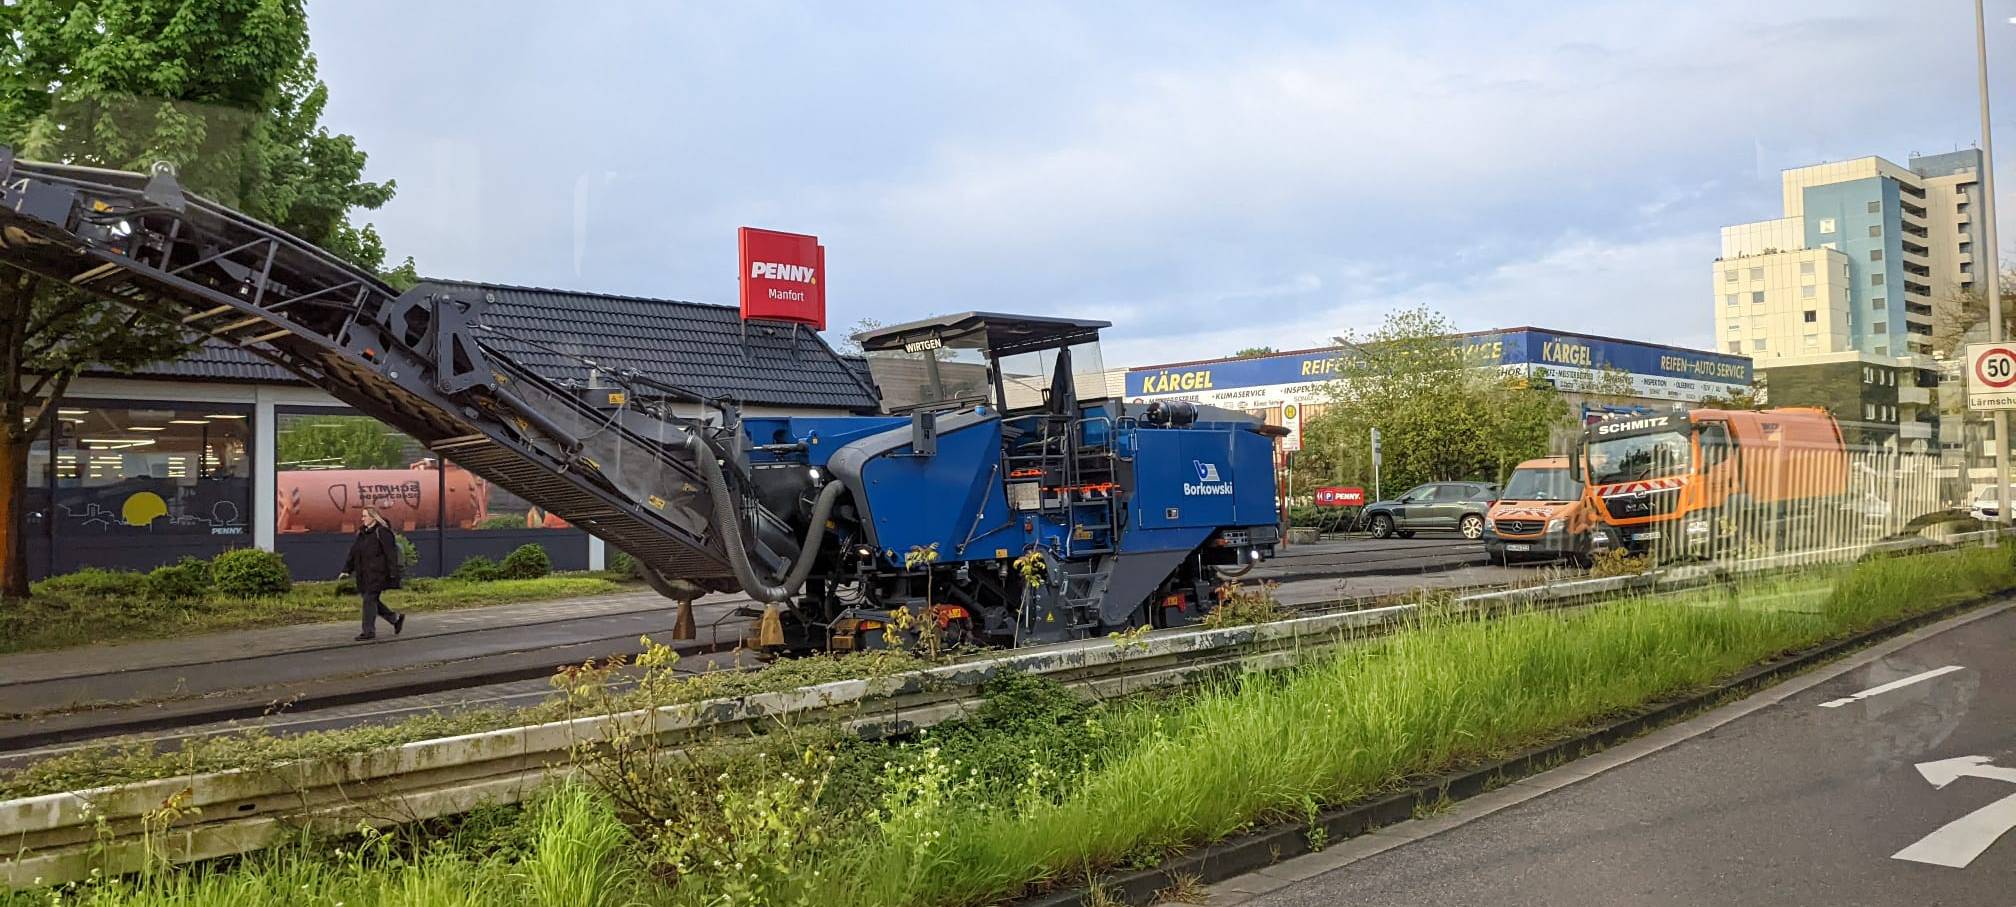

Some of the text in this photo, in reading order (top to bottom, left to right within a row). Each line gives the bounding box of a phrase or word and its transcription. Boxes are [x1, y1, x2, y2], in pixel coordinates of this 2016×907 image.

[768, 288, 804, 301] Manfort
[905, 338, 942, 353] WIRTGEN
[1543, 338, 1592, 366] KÄRGEL
[1717, 364, 1745, 379] SERVICE
[1987, 358, 2010, 377] 50
[1142, 370, 1213, 394] KÄRGEL
[1215, 389, 1266, 400] KLIMASERVICE
[1599, 416, 1669, 435] SCHMITZ
[1184, 482, 1233, 496] Borkowski
